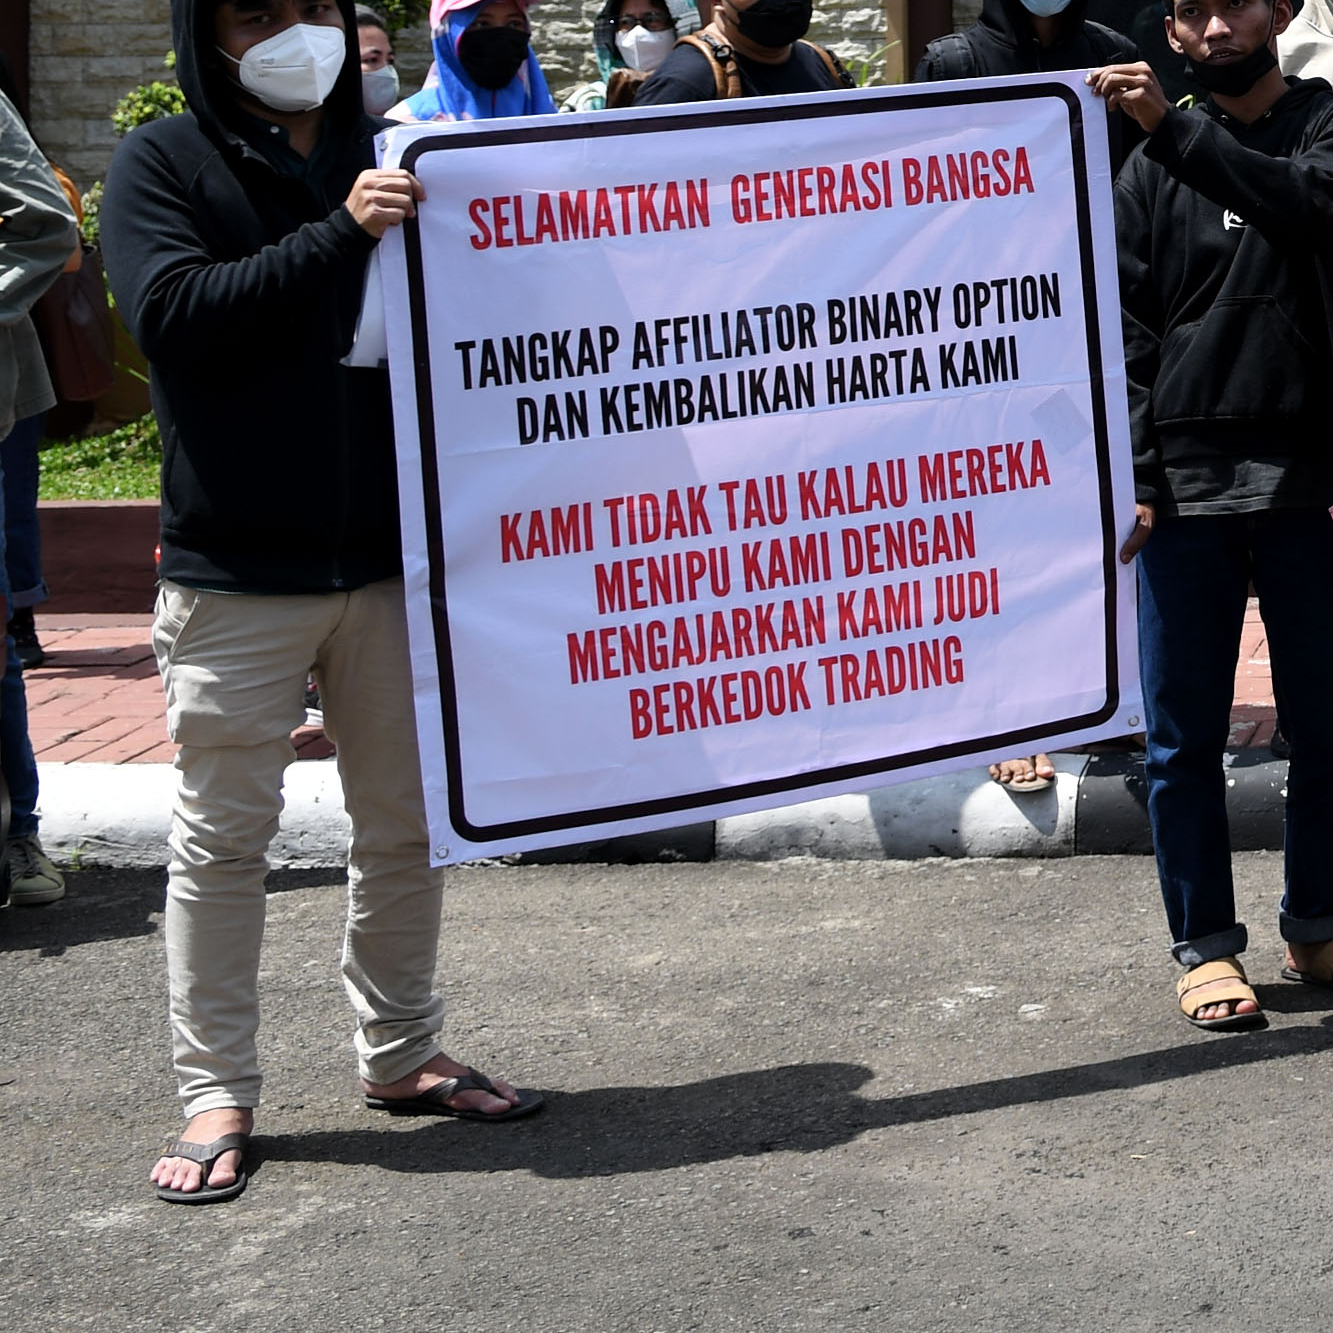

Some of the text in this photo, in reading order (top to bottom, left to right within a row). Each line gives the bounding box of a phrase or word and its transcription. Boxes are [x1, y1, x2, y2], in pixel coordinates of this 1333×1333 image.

[469, 147, 1034, 251] SELAMATKAN GENERASI BANGSA
[454, 272, 1062, 391] TANGKAP AFFILIATOR BINARY OPTION
[516, 335, 1019, 446] DAN KEMBALIKAN HARTA KAMI
[501, 439, 1051, 563] KAMI TIDAK TAU KALAU MEREKA
[594, 511, 976, 614] MENIPU KAMI DENGAN
[567, 568, 1000, 684] MENGAJARKAN KAMI JUDI
[629, 636, 964, 739] BERKEDOK TRADING
